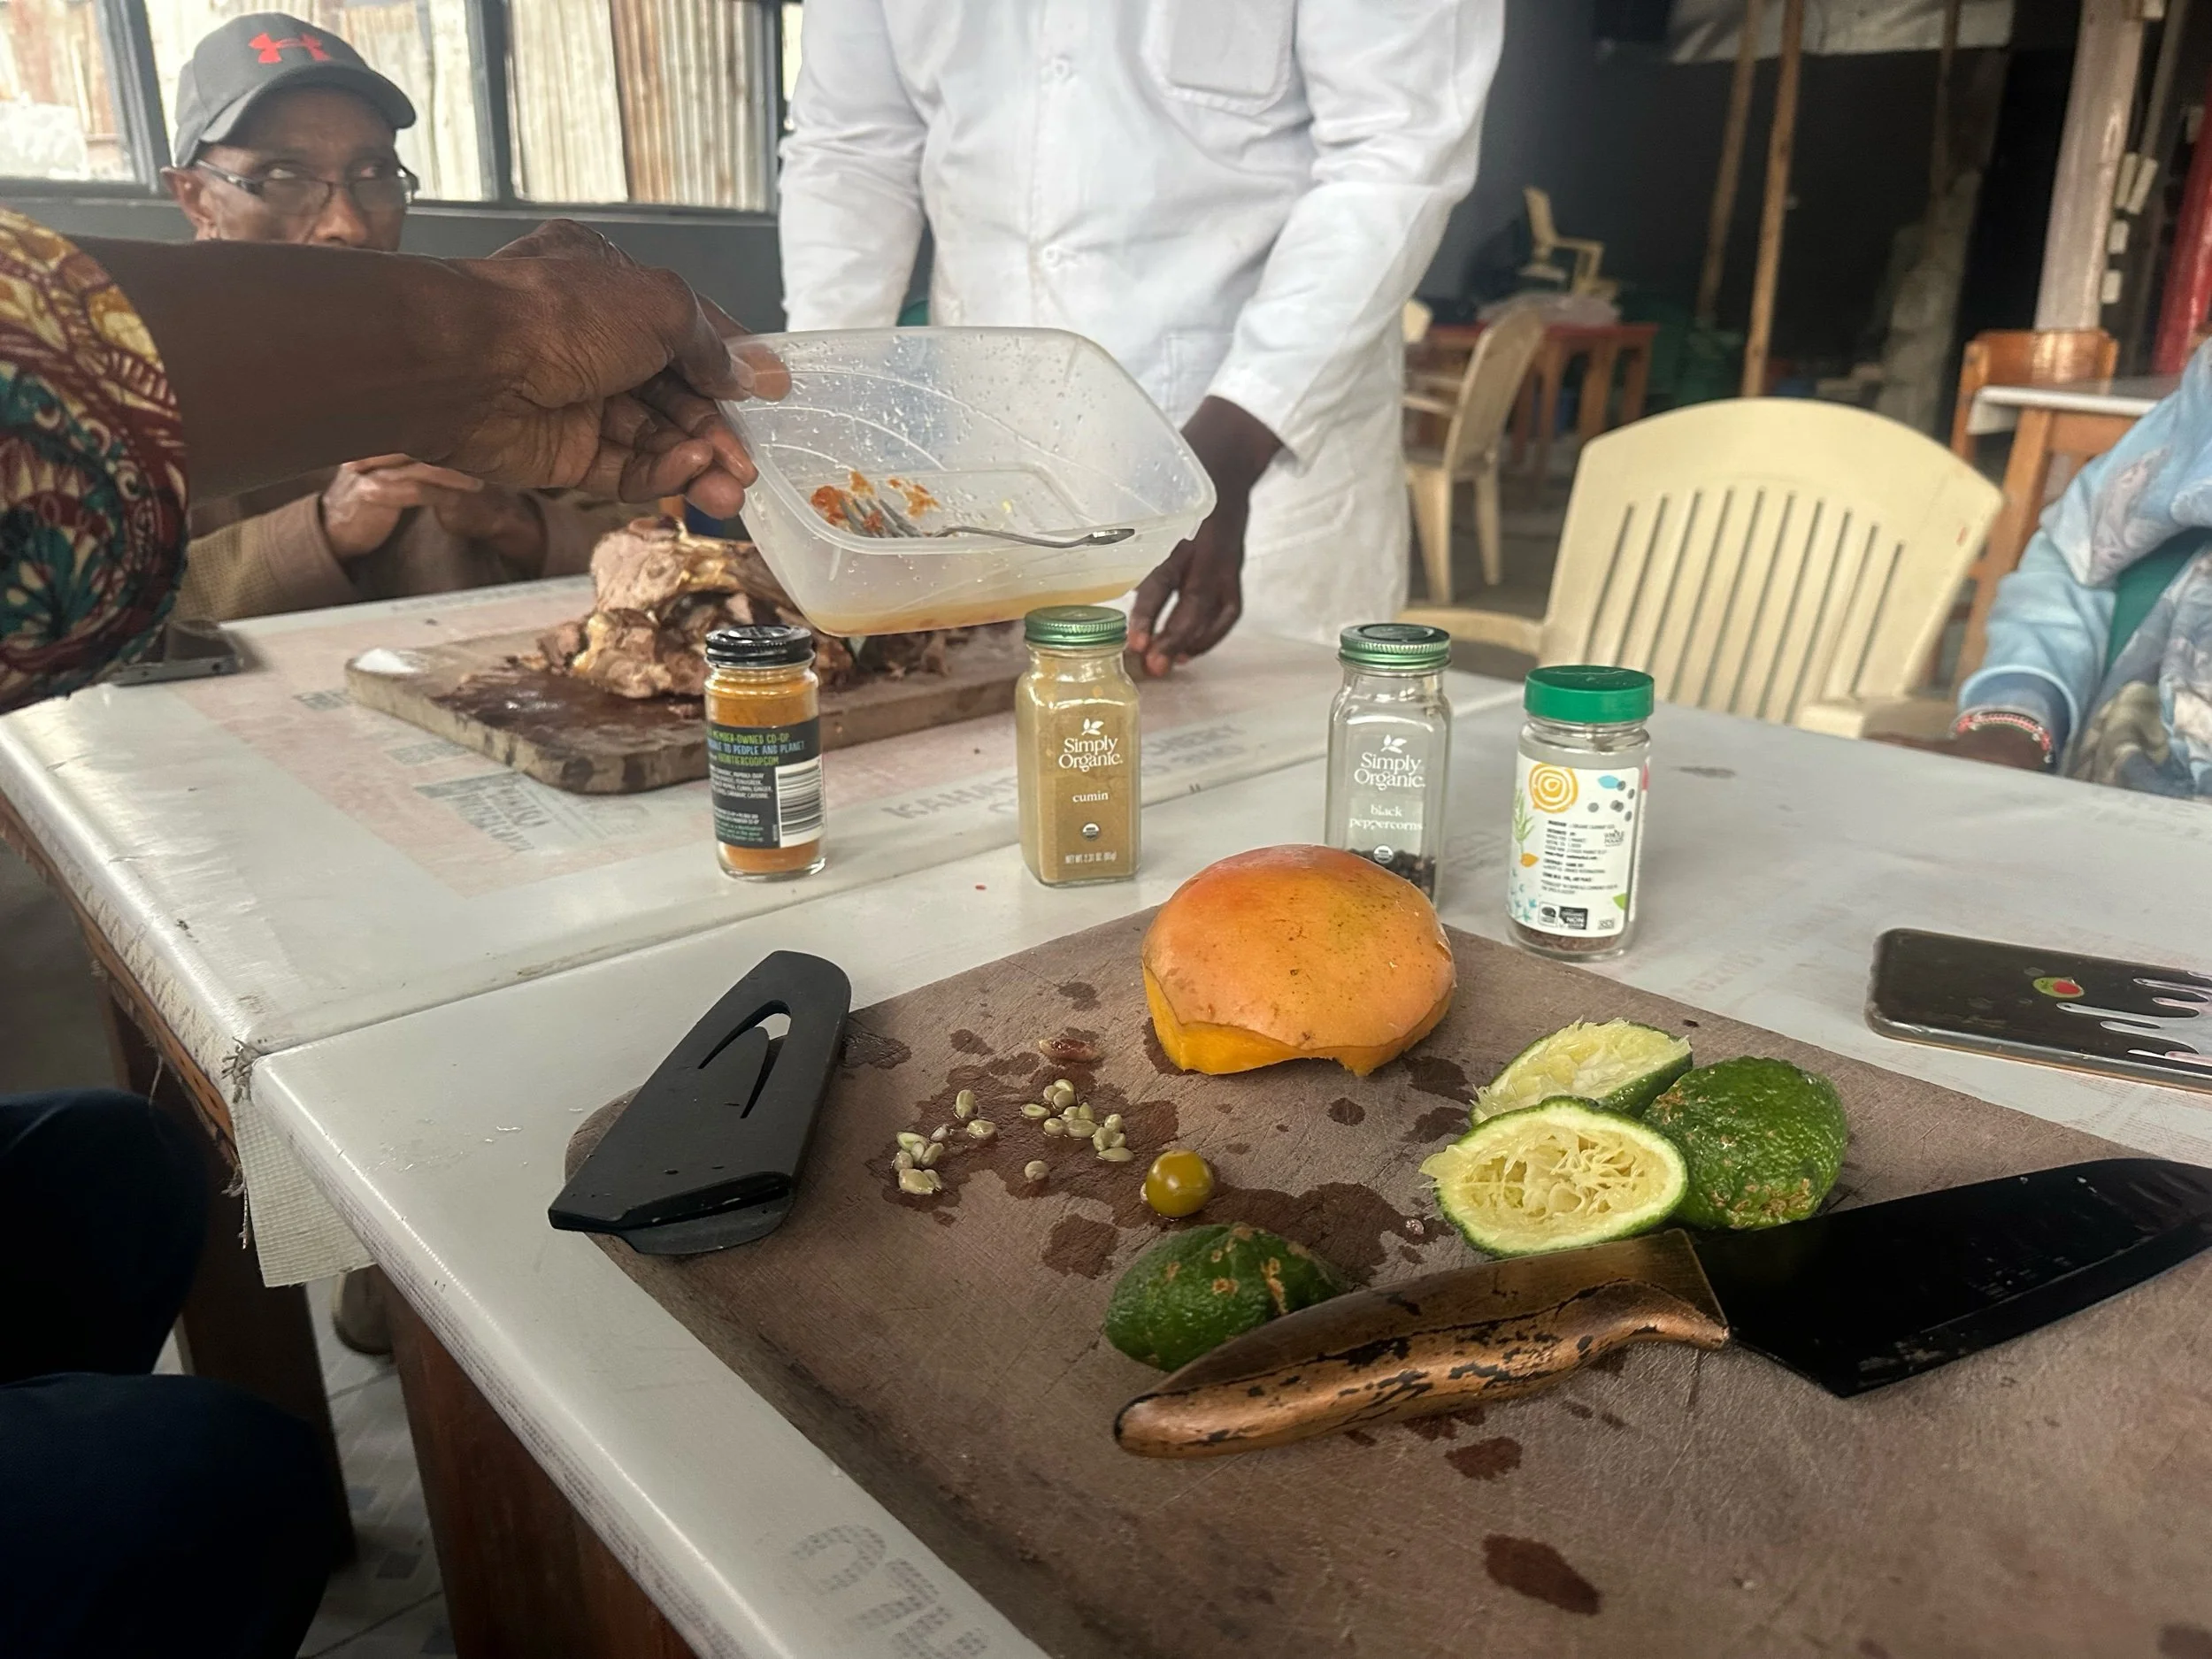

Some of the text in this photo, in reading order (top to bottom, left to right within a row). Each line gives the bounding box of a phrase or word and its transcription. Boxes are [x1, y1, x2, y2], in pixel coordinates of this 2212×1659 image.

[733, 744, 759, 756] PEOPLE
[762, 744, 779, 755] AND
[1064, 734, 1118, 756] Simply
[1361, 752, 1421, 775] Simply
[1072, 790, 1109, 803] cumin
[1370, 804, 1402, 817] black
